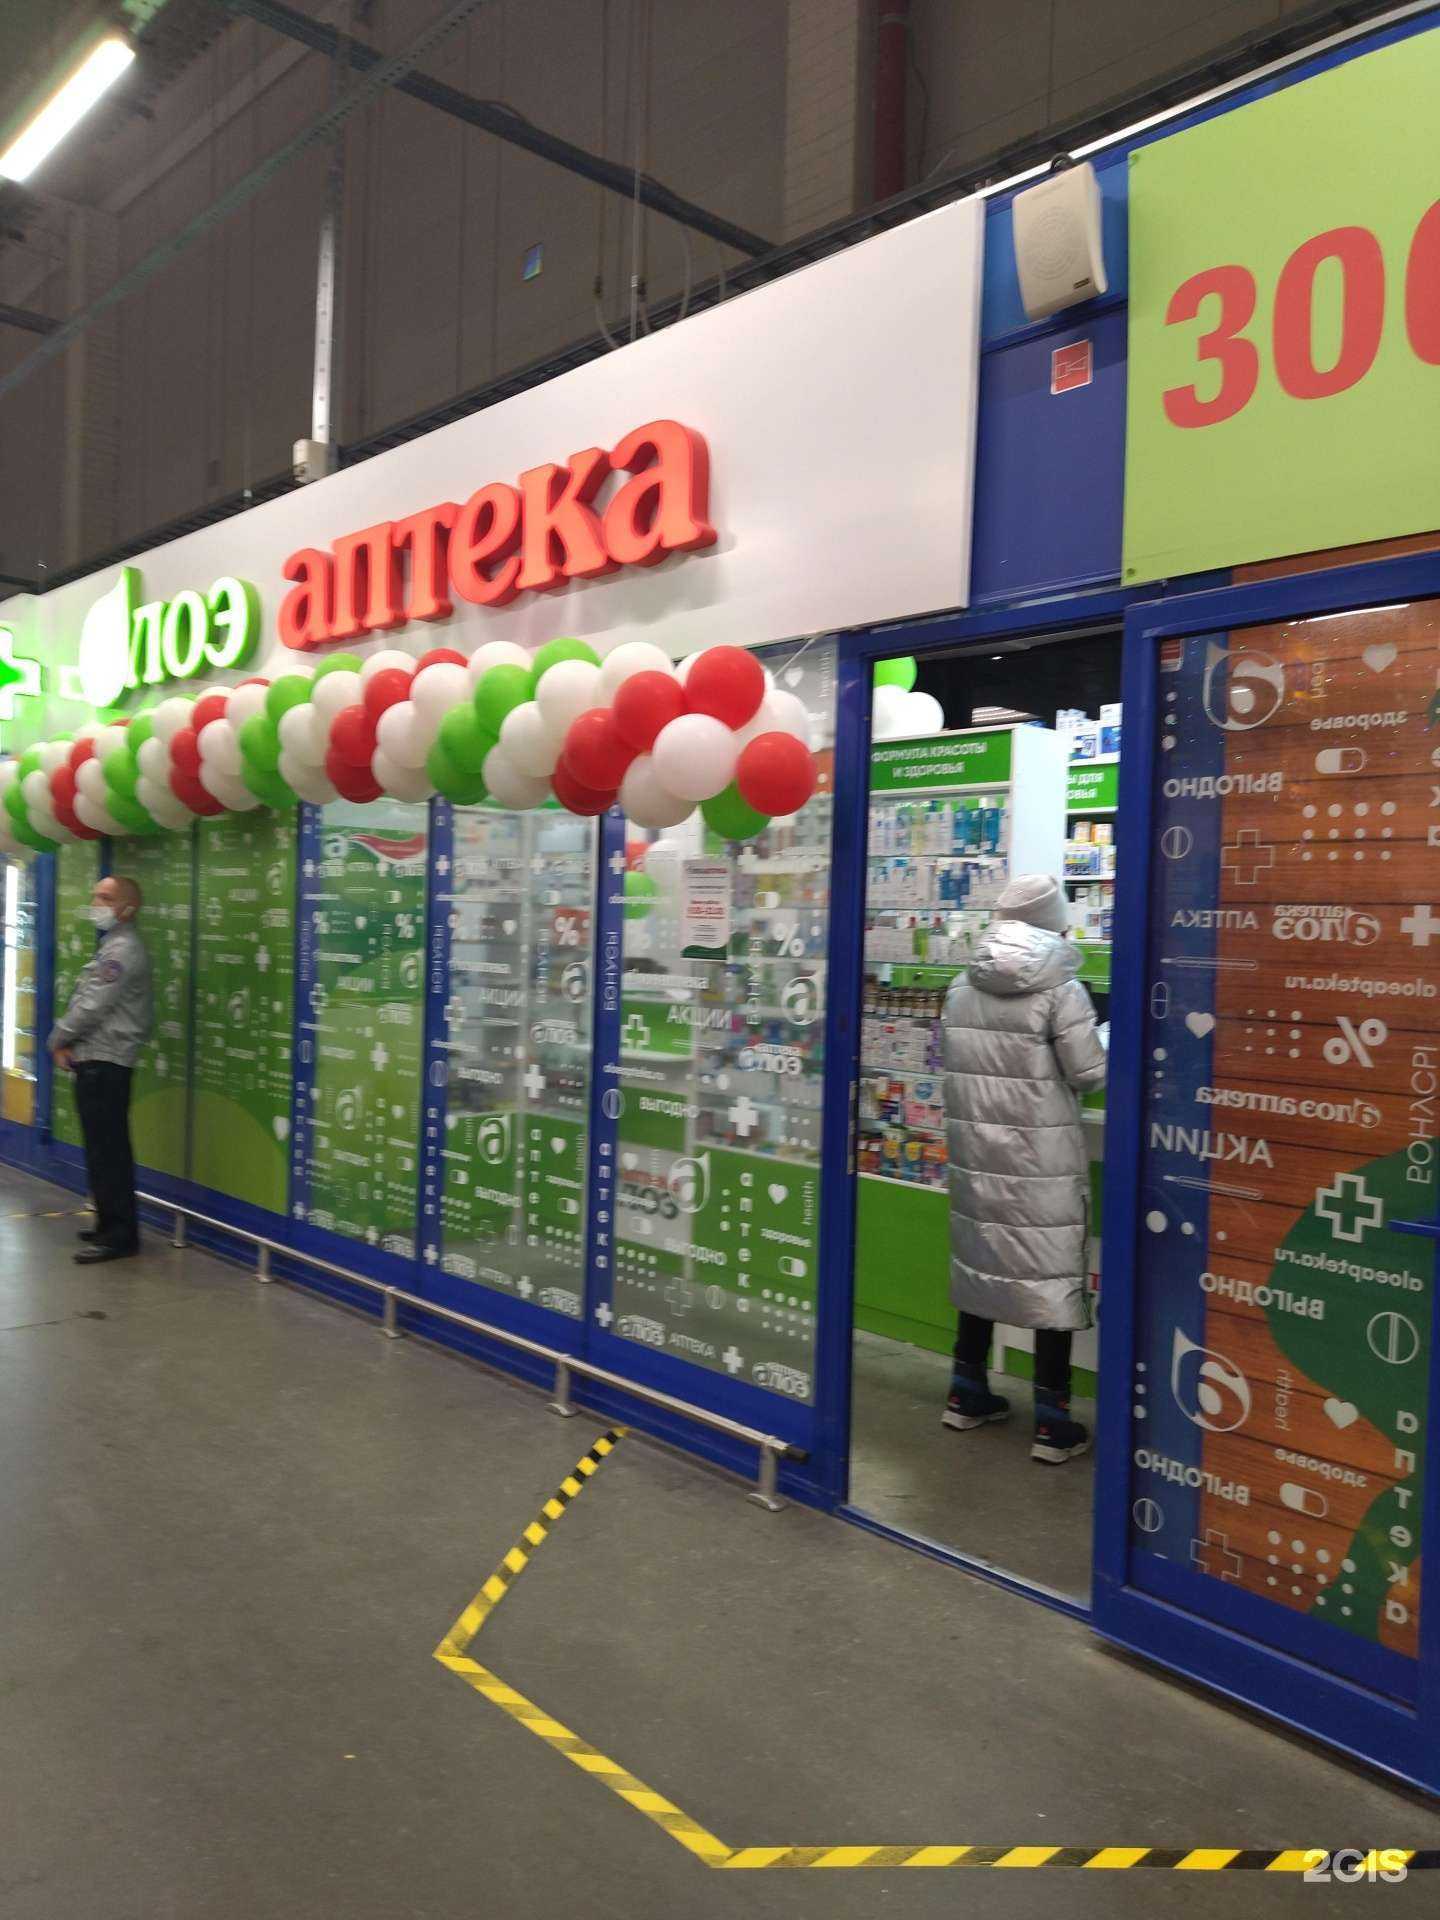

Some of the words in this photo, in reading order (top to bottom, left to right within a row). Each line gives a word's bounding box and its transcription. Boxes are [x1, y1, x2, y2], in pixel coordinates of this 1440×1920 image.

[278, 419, 718, 652] аптека
[604, 931, 619, 1011] БОНУСЫ
[667, 1004, 732, 1031] АКЦИИ
